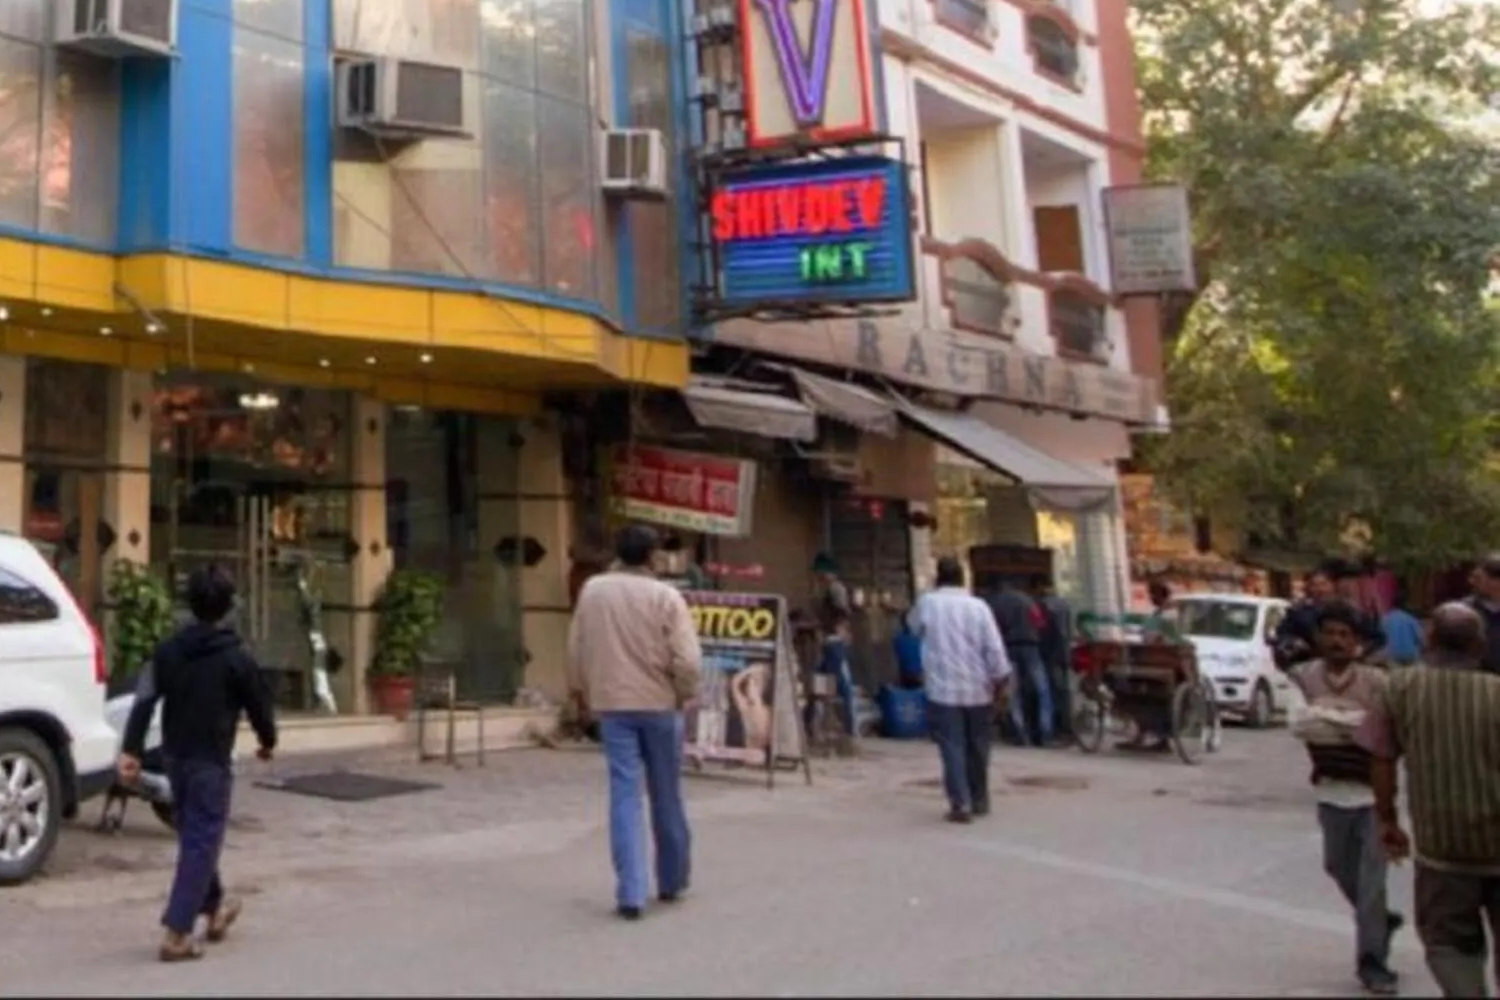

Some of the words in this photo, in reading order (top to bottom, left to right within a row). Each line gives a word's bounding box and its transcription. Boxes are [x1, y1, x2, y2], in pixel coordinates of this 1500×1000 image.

[711, 175, 887, 240] SHIVDEV
[800, 241, 875, 281] INT
[855, 319, 1082, 407] RACHNA
